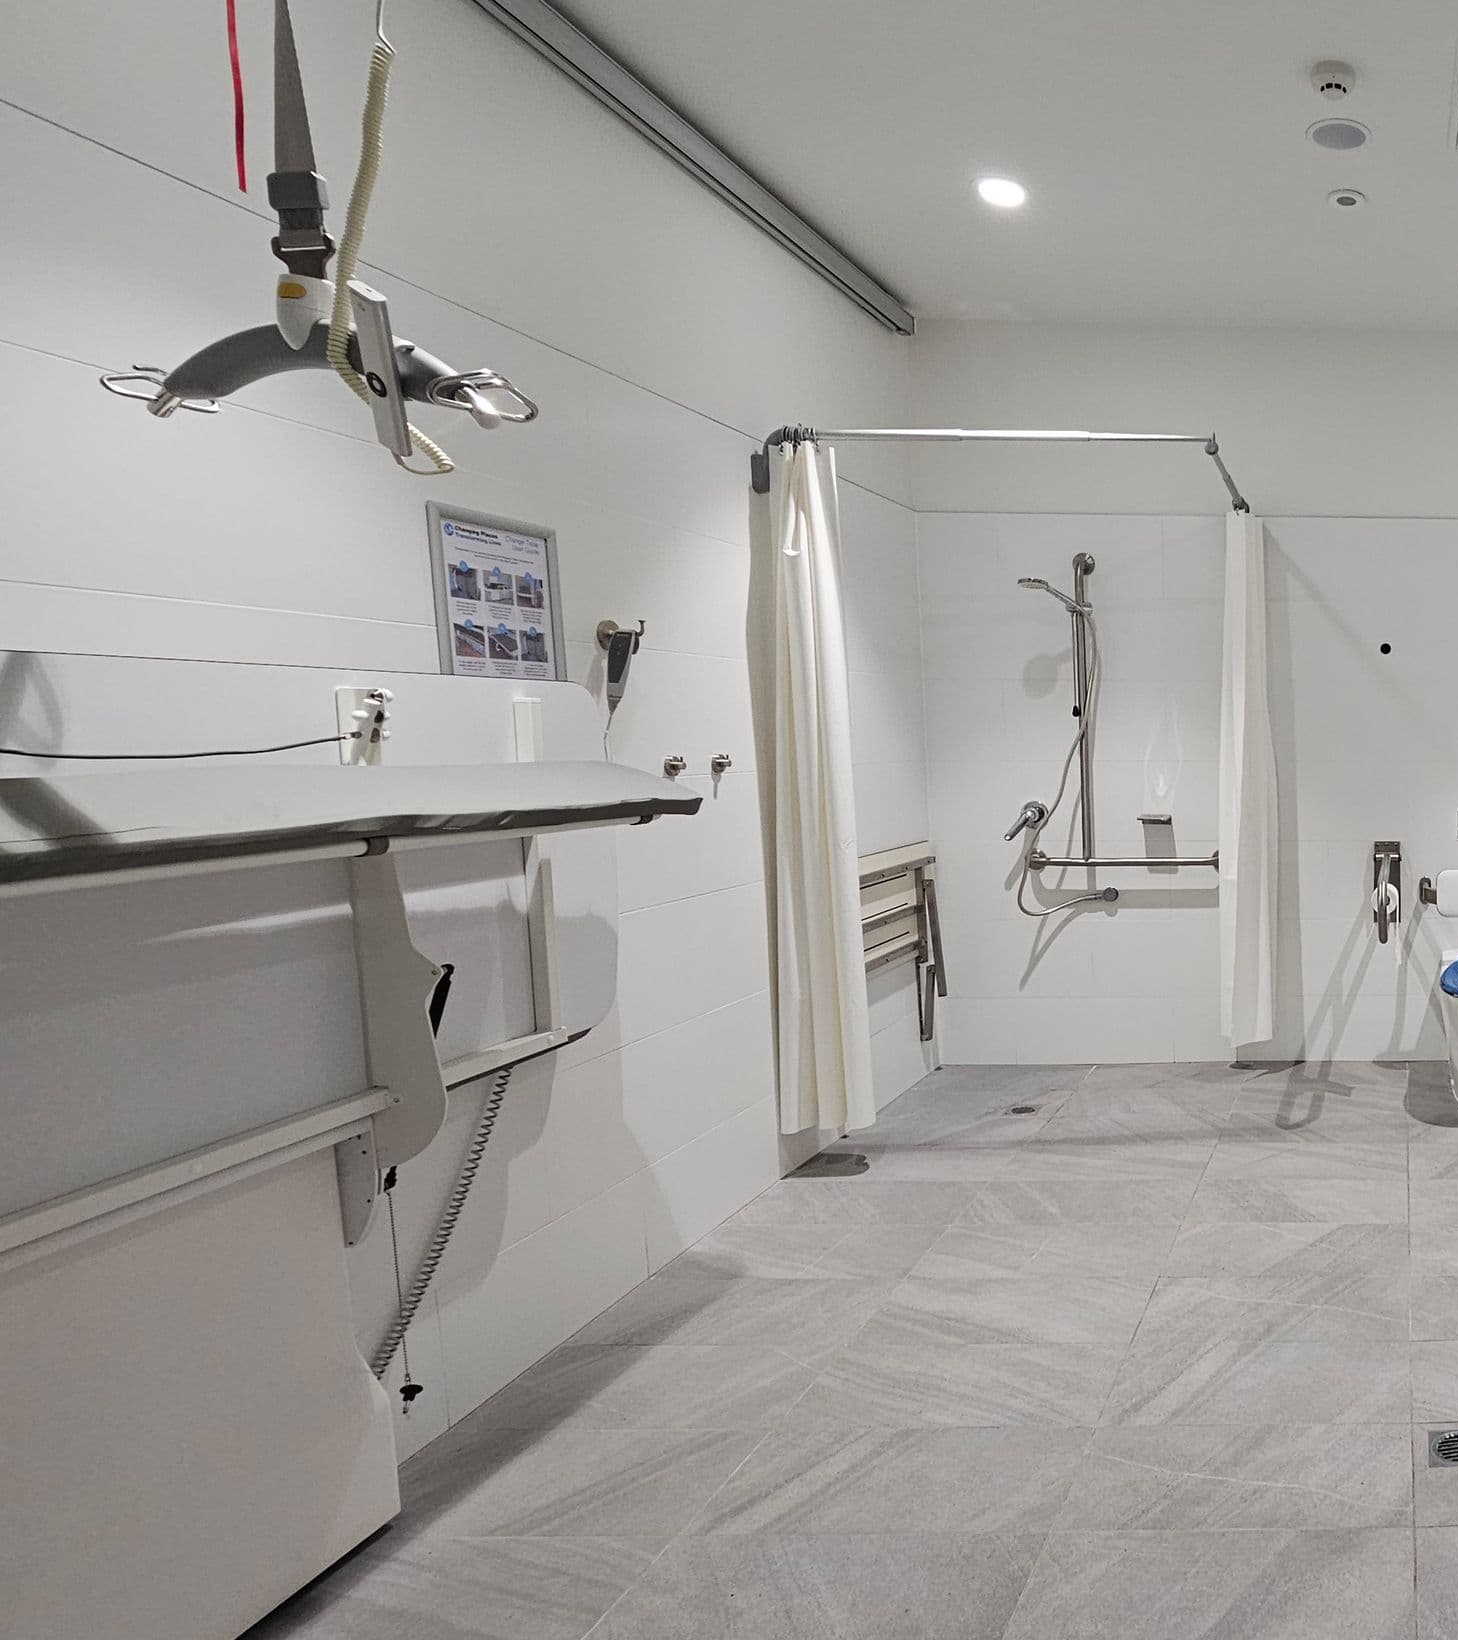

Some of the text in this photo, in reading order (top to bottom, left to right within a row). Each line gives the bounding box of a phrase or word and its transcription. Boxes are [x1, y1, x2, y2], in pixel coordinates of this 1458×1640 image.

[454, 525, 498, 539] Changing Places
[455, 531, 488, 545] Transforming
